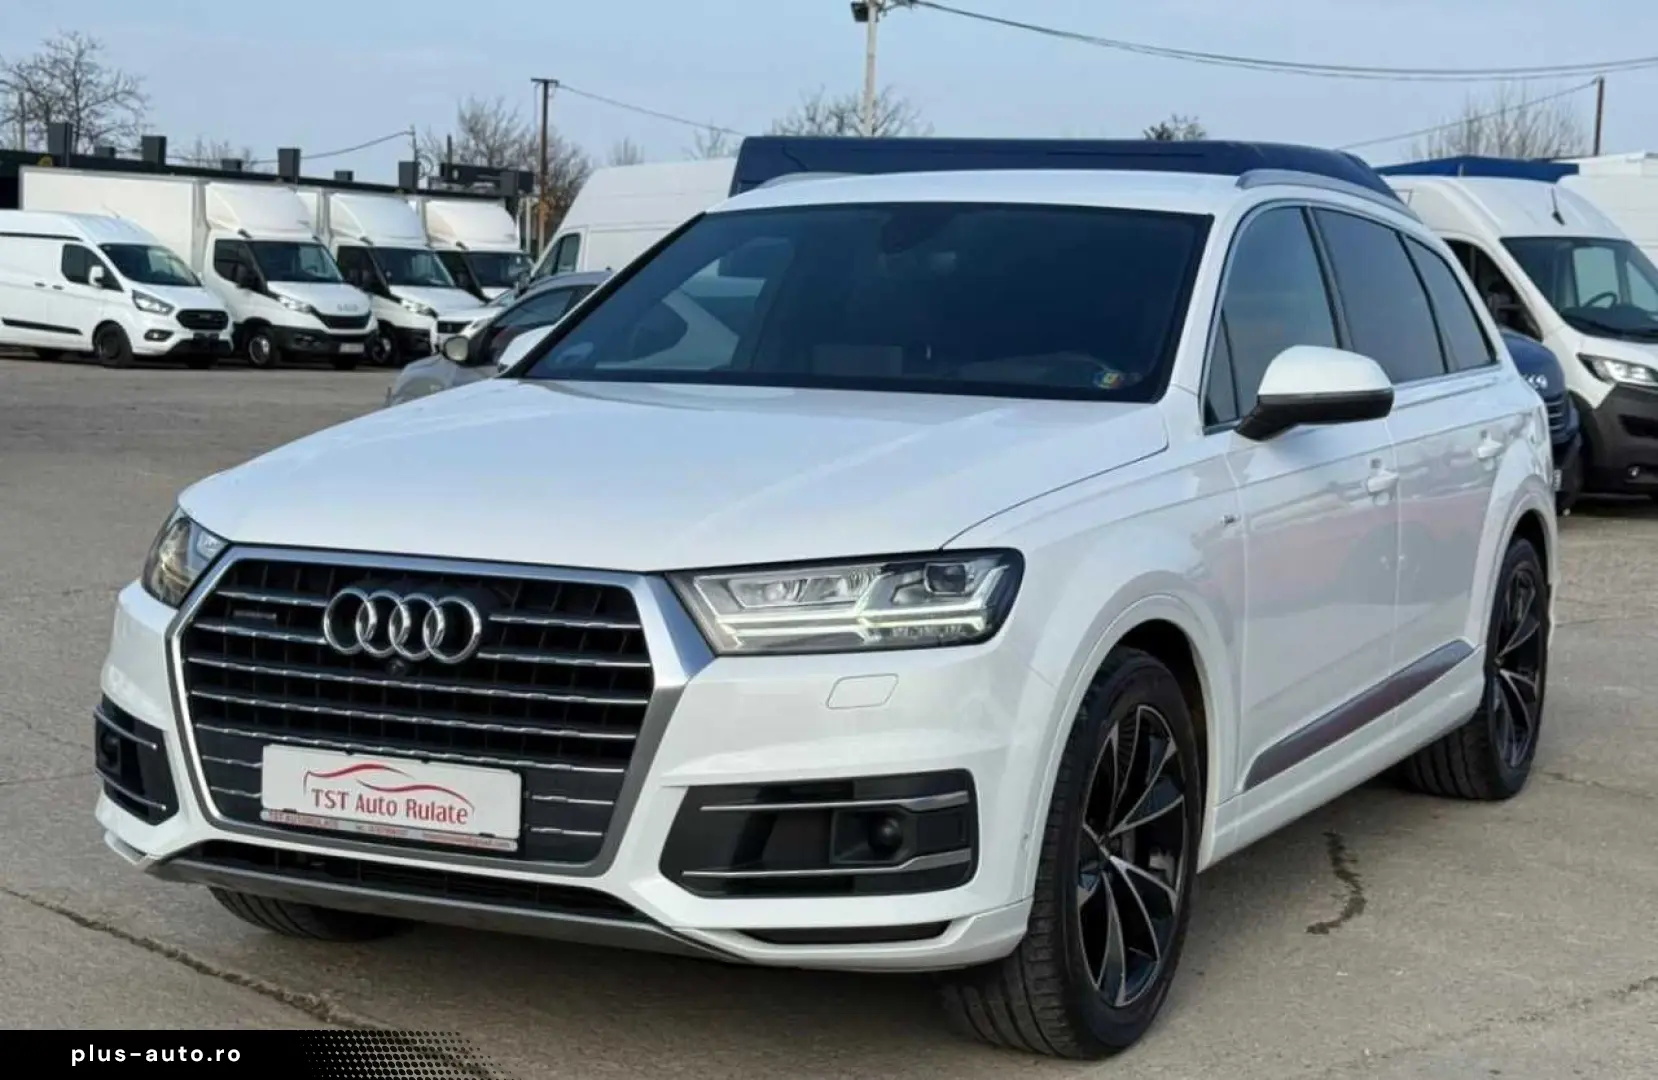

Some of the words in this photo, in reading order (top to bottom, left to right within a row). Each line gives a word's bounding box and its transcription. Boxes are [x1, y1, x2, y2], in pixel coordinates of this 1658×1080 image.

[312, 788, 349, 810] TST
[355, 793, 397, 817] Auto
[405, 798, 468, 825] Rulate
